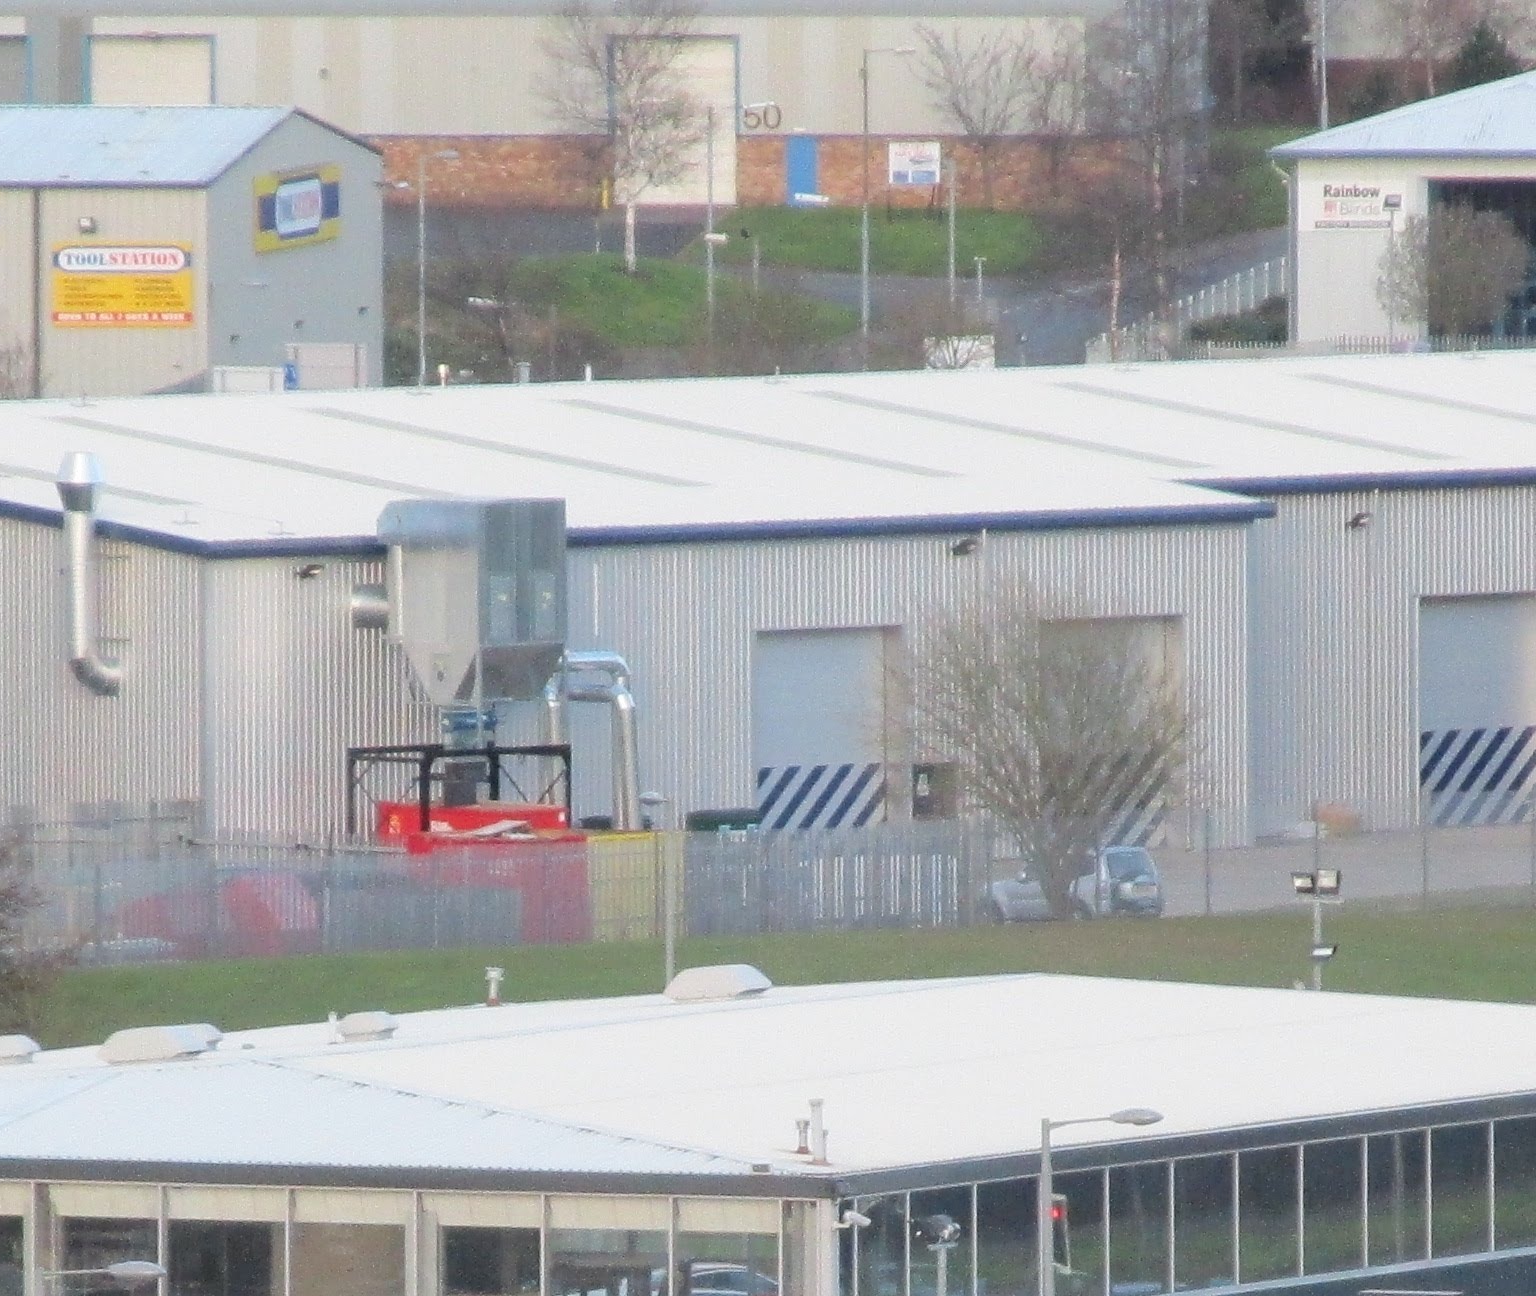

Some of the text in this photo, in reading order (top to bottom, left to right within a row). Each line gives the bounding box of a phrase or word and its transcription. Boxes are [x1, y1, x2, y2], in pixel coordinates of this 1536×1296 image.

[744, 103, 781, 129] 50
[1323, 184, 1381, 198] Rainbow
[66, 253, 179, 266] TOOLSTATION
